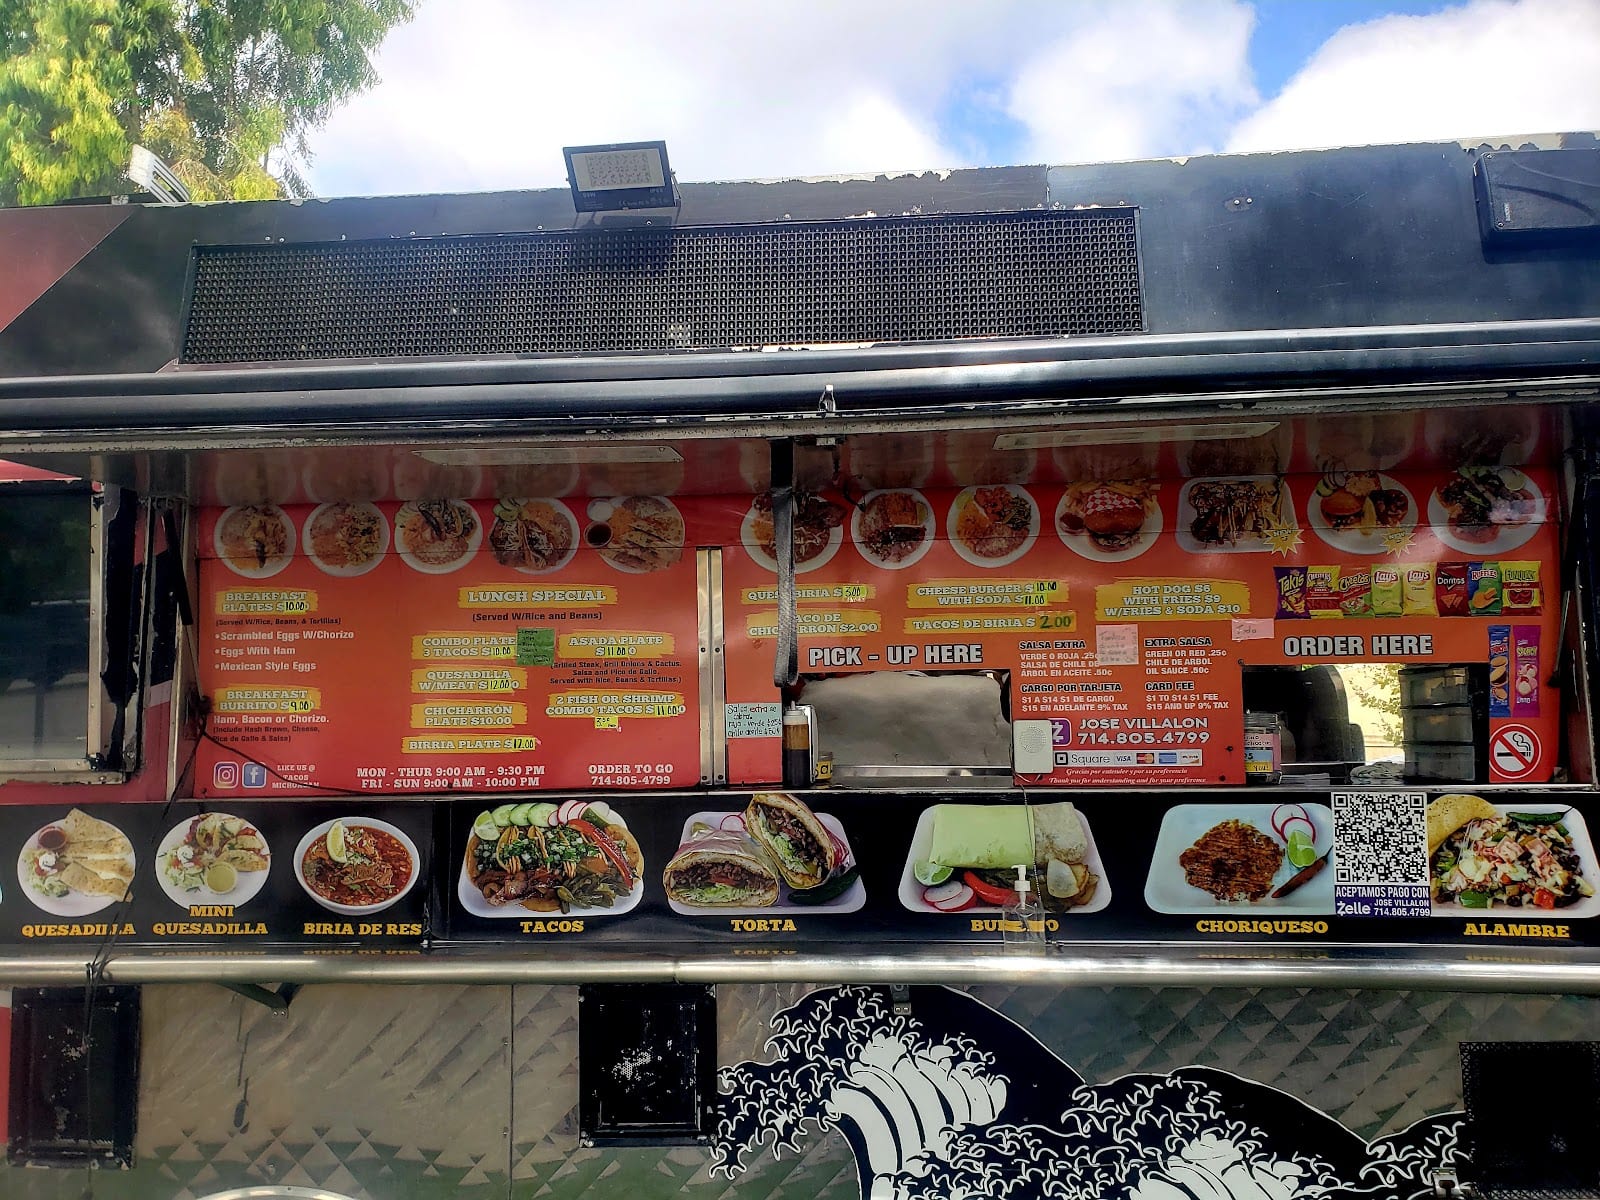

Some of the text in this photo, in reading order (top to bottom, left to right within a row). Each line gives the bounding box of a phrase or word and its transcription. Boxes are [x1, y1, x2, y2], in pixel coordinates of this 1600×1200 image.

[1278, 573, 1305, 595] Takis
[1339, 574, 1370, 592] Cheetos
[1437, 576, 1465, 585] Doritos
[916, 587, 967, 595] CHEESE
[969, 585, 1022, 594] BURGER
[1133, 586, 1191, 594] HOT DOG
[225, 591, 307, 601] BREAKFAST
[468, 590, 606, 602] LUNCH SPECIAL
[937, 596, 971, 605] WITH
[975, 596, 1011, 604] SODA
[1123, 595, 1201, 606] WITH FRIES
[222, 602, 273, 612] PLATES
[1105, 605, 1240, 616] W/FRIES SODA $10
[548, 612, 566, 620] and
[824, 613, 841, 622] DE
[839, 623, 878, 633] $2.00
[912, 620, 959, 630] TACOS
[963, 620, 981, 628] DE
[983, 619, 1024, 628] BIRIA
[220, 631, 354, 642] Scrambled Eggs W/Chorizo
[422, 637, 516, 646] COMBO PLATE
[569, 636, 663, 646] ASADA PLATE
[1019, 640, 1086, 650] SALSA EXTRA
[1144, 637, 1212, 648] EXTRA SALSA
[1284, 635, 1433, 656] ORDER HERE
[220, 646, 296, 657] Eggs With Ham
[434, 648, 478, 656] TACOS
[809, 644, 983, 667] PICK UP HERE
[220, 662, 316, 672] Mexican Style Eggs
[1146, 667, 1159, 675] OIL
[426, 671, 511, 680] QUESADILLA
[419, 682, 475, 690] W/MEAT
[1020, 683, 1122, 693] CARGO POR TARJETA
[1145, 681, 1195, 691] CARD FEE
[226, 690, 308, 699] BREAKFAST
[567, 694, 675, 704] FISH OR SHRIMP
[219, 701, 277, 711] BURRITO
[424, 704, 513, 715] CHICHARRÓN
[545, 705, 643, 715] COMBO TACOS
[1022, 704, 1037, 712] $15
[242, 715, 273, 724] Bacon
[288, 714, 330, 723] Chorizo.
[425, 717, 512, 726] PLATE $10.00
[1079, 718, 1209, 729] JOSE VILLALON
[1077, 732, 1210, 745] 714.805.4799
[409, 741, 455, 750] BIRRIA
[458, 740, 500, 749] PLATE
[1071, 754, 1111, 766] Square
[357, 766, 545, 777] MON THUR 9:00 AM 9:30 PM
[588, 765, 674, 774] ORDER TO GO
[361, 778, 539, 788] FRI SUN 9:00 AM 10:00 PM
[591, 776, 671, 785] 714-805-4799
[1336, 886, 1429, 899] ACEPTAMOS PAGO CON
[1374, 899, 1430, 907] JOSE VILLALON
[190, 905, 234, 917] MINI
[1373, 908, 1430, 917] 714.805.4799
[152, 922, 268, 937] QUESADILLA
[303, 922, 422, 936] BIRIA DE RES
[520, 920, 584, 934] TACOS
[731, 919, 797, 932] TORTA
[1195, 919, 1329, 935] CHORIQUESO
[1463, 922, 1570, 938] ALAMBRE
